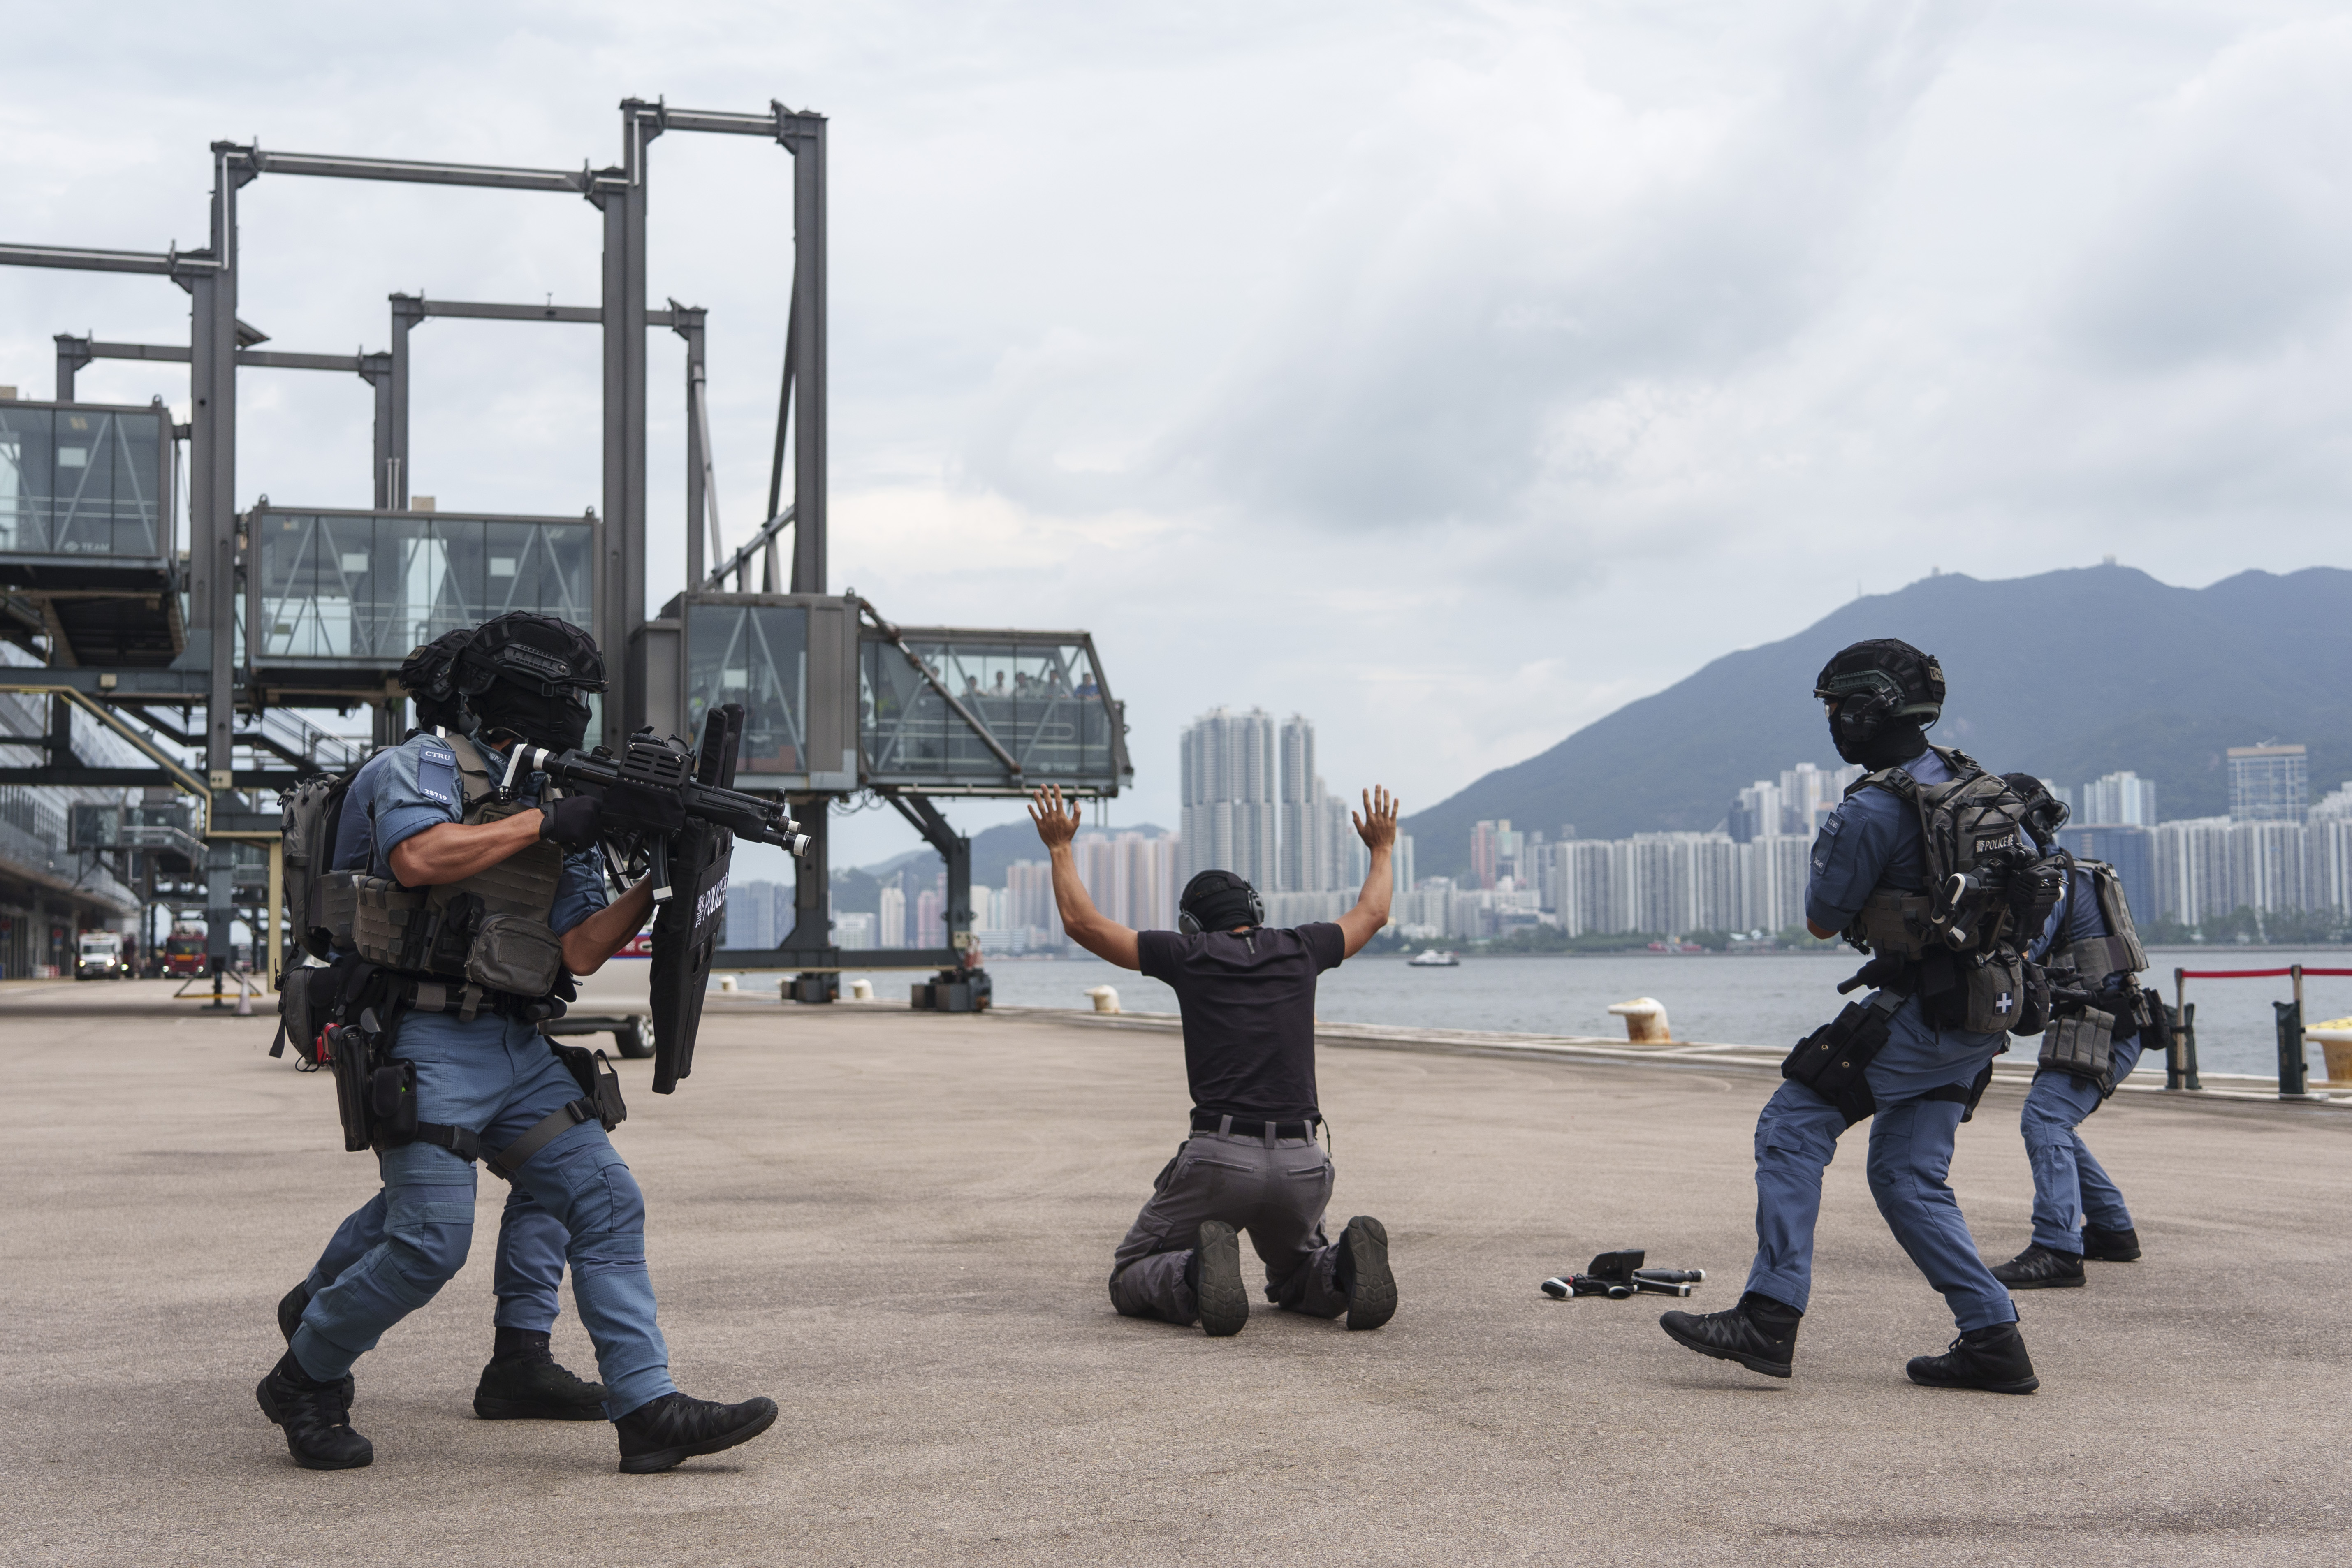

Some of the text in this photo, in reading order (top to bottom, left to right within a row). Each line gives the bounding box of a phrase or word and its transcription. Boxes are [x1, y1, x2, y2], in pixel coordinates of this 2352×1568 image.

[425, 751, 450, 760] CTRU
[494, 755, 507, 767] POLIC
[424, 789, 447, 801] 28719
[1828, 818, 1839, 829] CTRU
[1984, 836, 2007, 851] POLICE
[702, 876, 725, 921] POLICE
